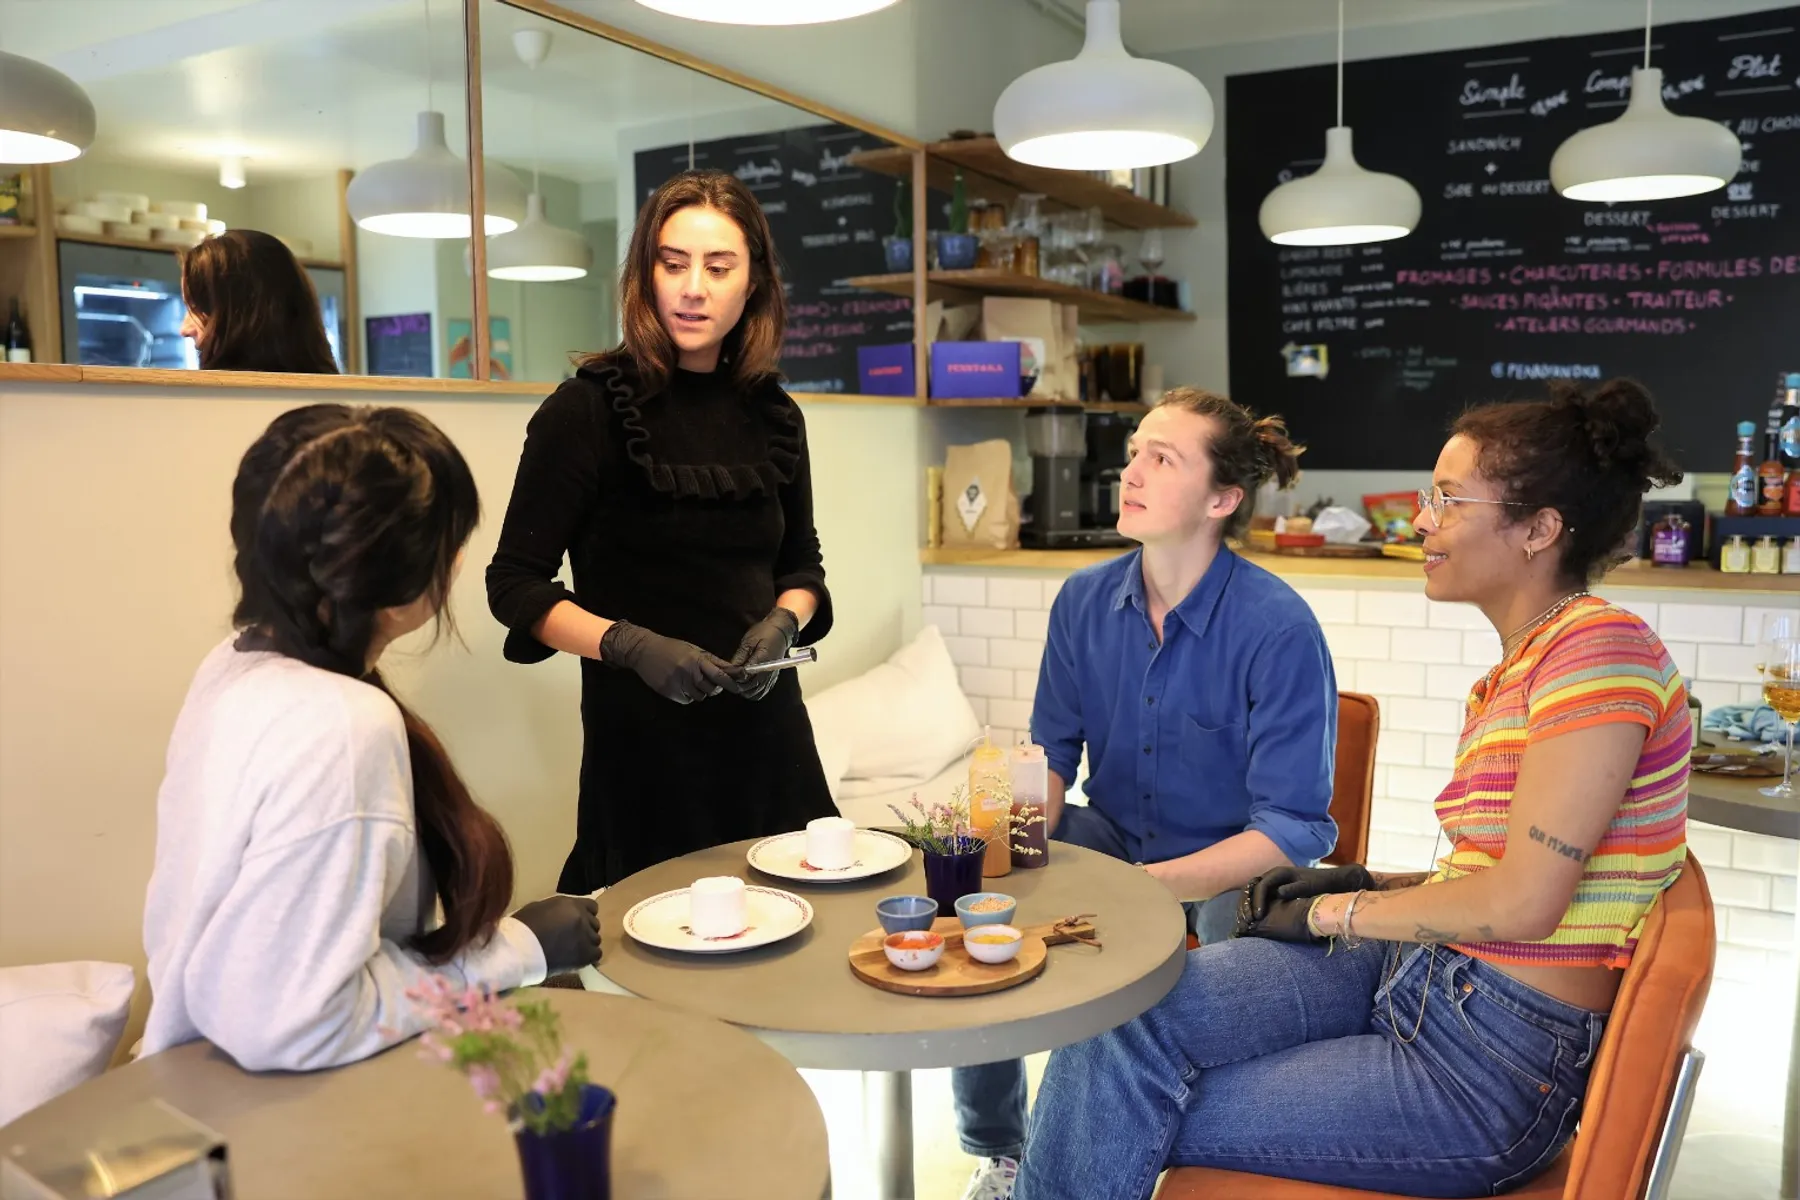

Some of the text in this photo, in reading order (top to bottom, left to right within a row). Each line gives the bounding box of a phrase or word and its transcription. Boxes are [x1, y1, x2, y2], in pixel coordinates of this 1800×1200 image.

[1585, 69, 1631, 98] Comp
[1584, 211, 1652, 229] DESSERT
[1712, 204, 1779, 218] DESSERT
[1397, 268, 1491, 285] FROMAGES
[1658, 258, 1762, 281] FORMULES
[1627, 289, 1722, 309] TRAITEUR
[1584, 317, 1686, 334] GOURMANDS
